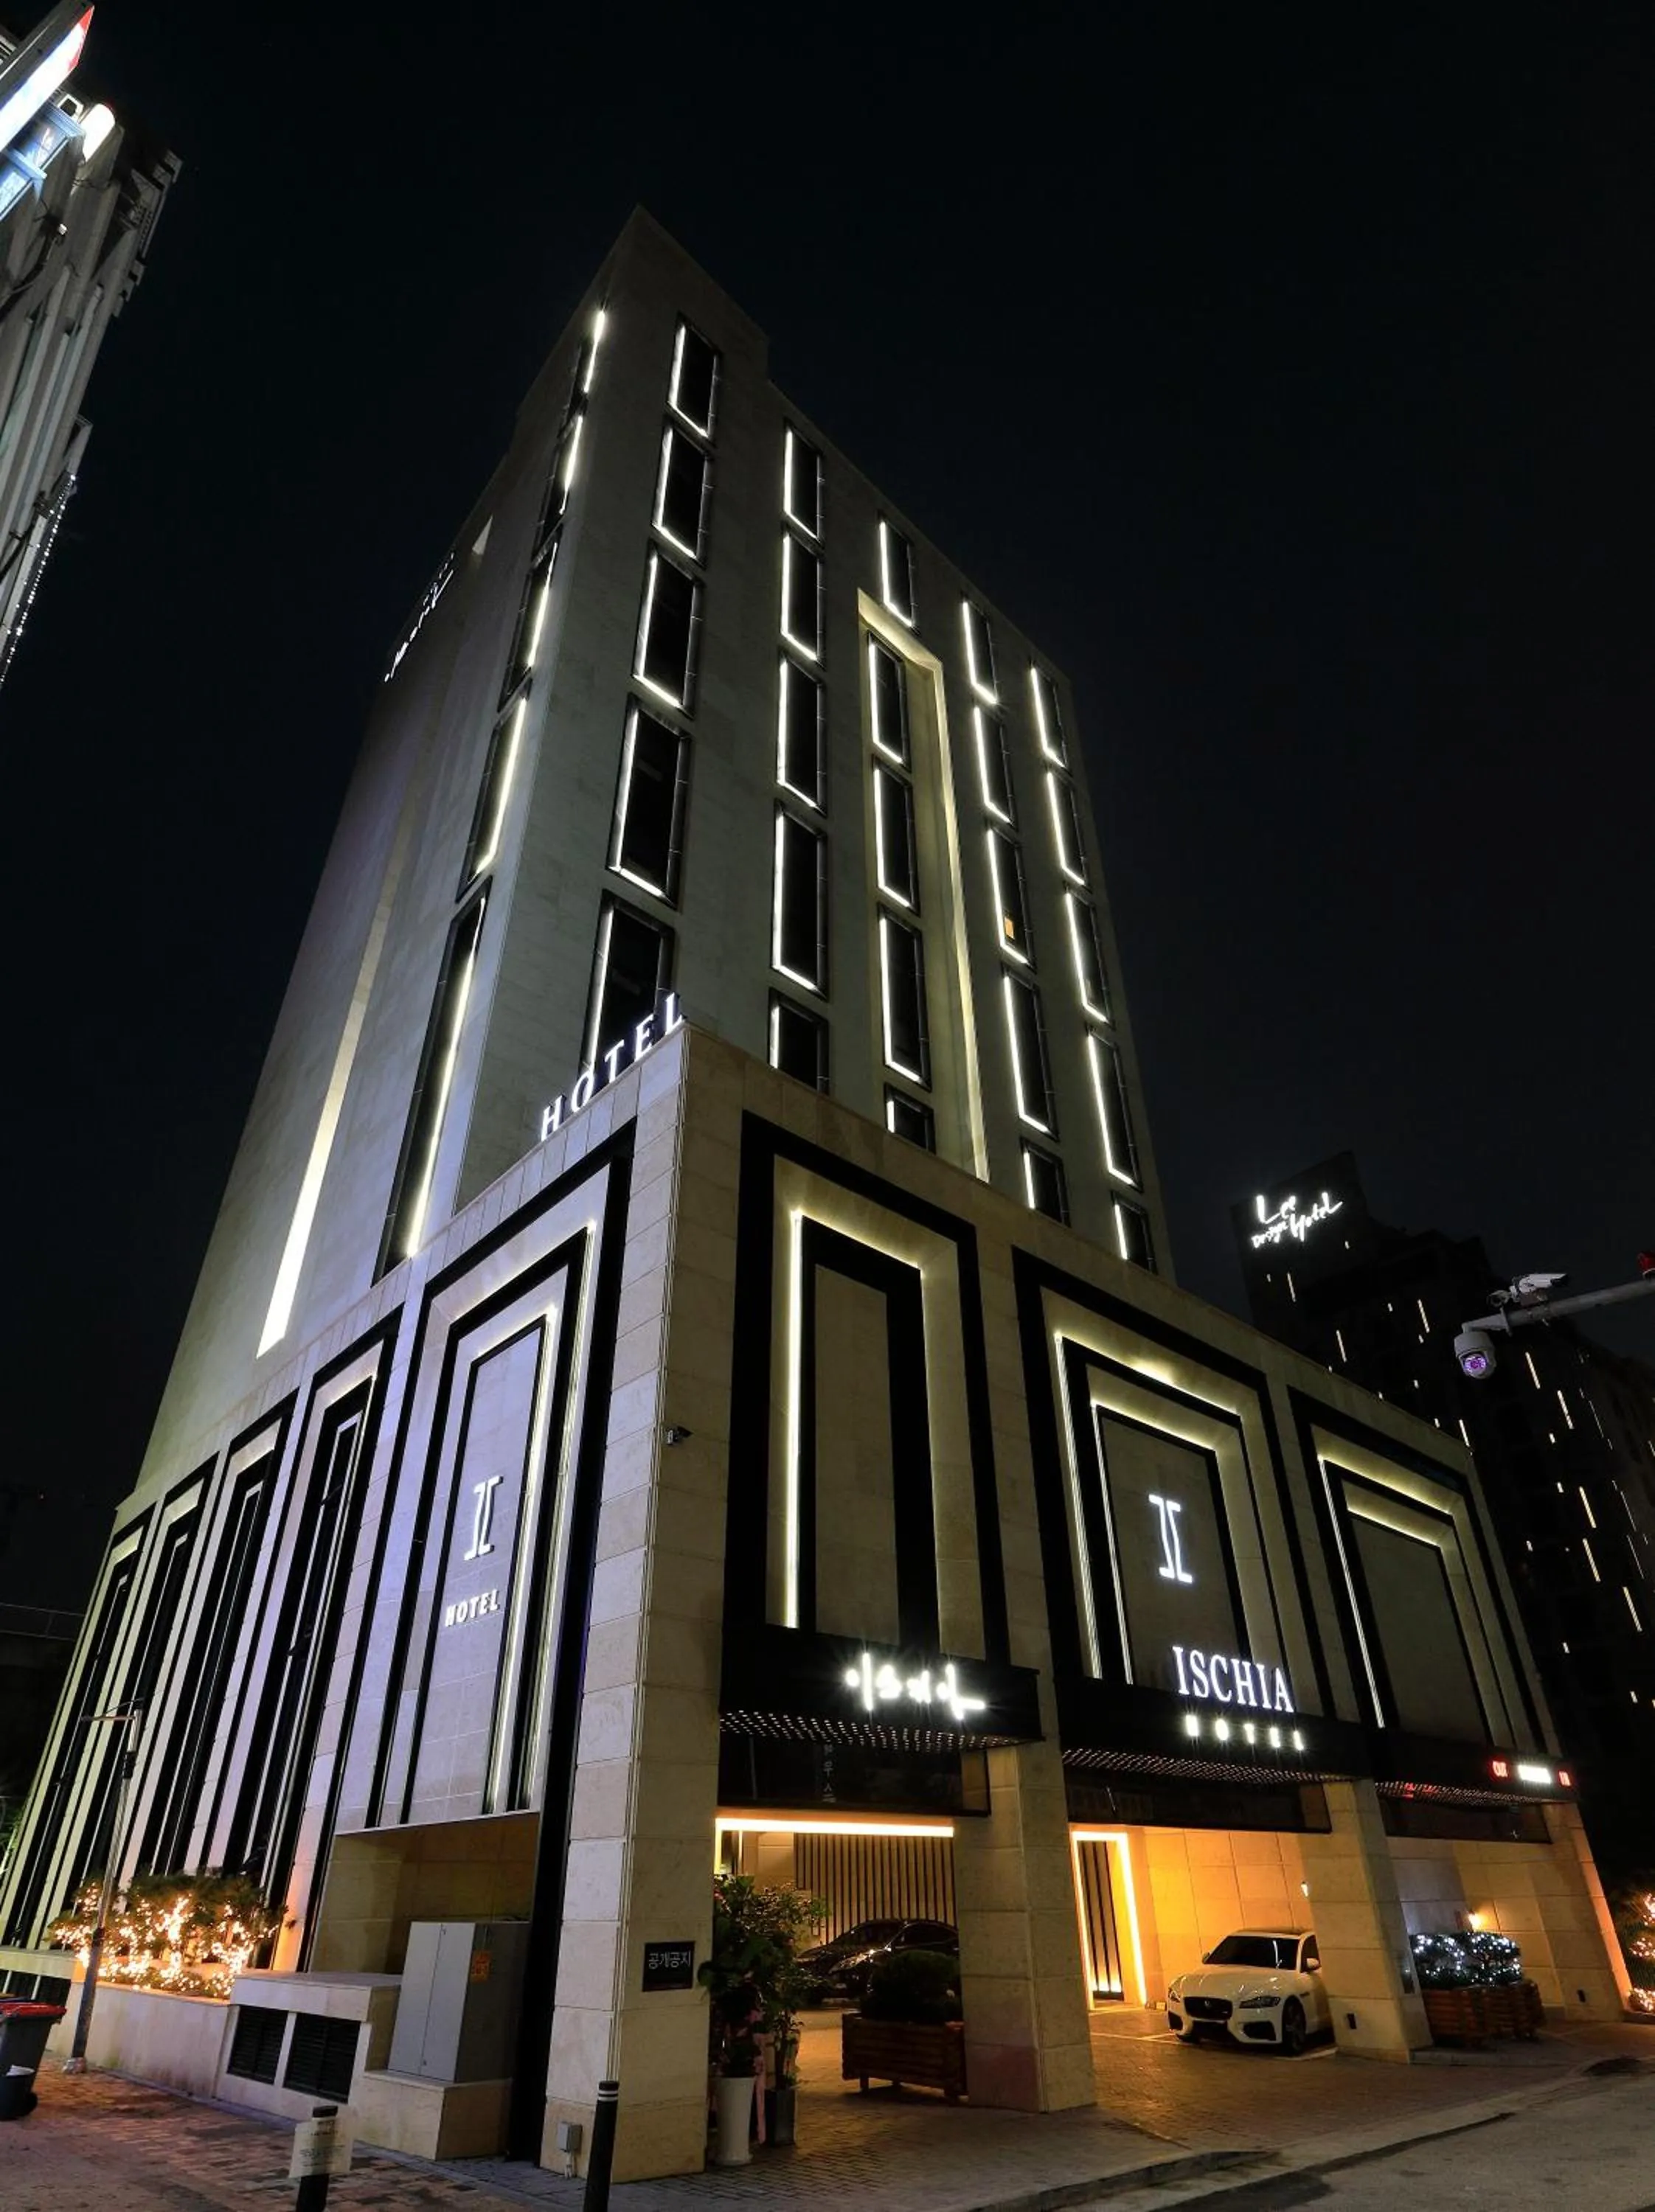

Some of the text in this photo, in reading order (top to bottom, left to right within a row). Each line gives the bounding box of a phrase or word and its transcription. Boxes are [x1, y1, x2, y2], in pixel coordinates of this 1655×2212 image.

[541, 992, 686, 1142] HOTEL
[445, 1589, 499, 1627] HOTEL
[1173, 1646, 1295, 1714] ISCHIA
[648, 1950, 691, 1969] 공개공지
